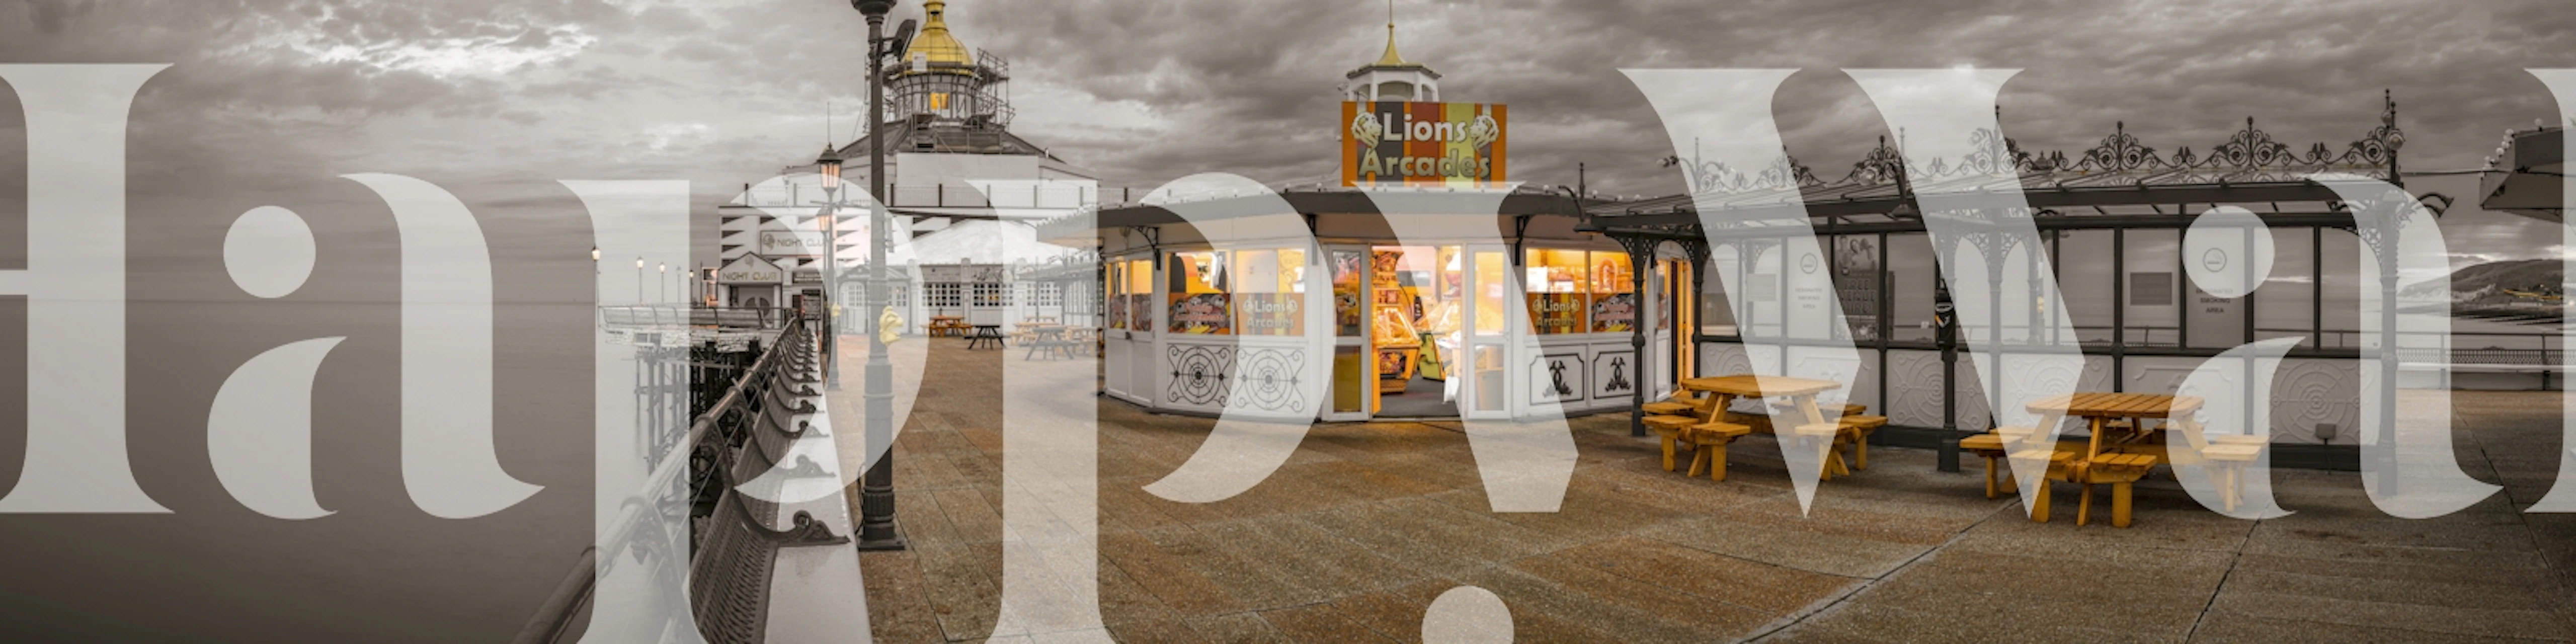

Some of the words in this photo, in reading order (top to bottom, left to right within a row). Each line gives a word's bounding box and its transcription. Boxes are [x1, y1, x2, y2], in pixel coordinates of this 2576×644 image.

[1384, 112, 1467, 143] Lions
[1358, 148, 1491, 177] Arcades
[722, 272, 749, 280] NIGHT
[753, 272, 776, 280] CLUB
[1254, 301, 1285, 313] Lions
[1543, 298, 1570, 312] Lions
[1246, 316, 1294, 328] Arcades
[1536, 315, 1577, 327] Arcades
